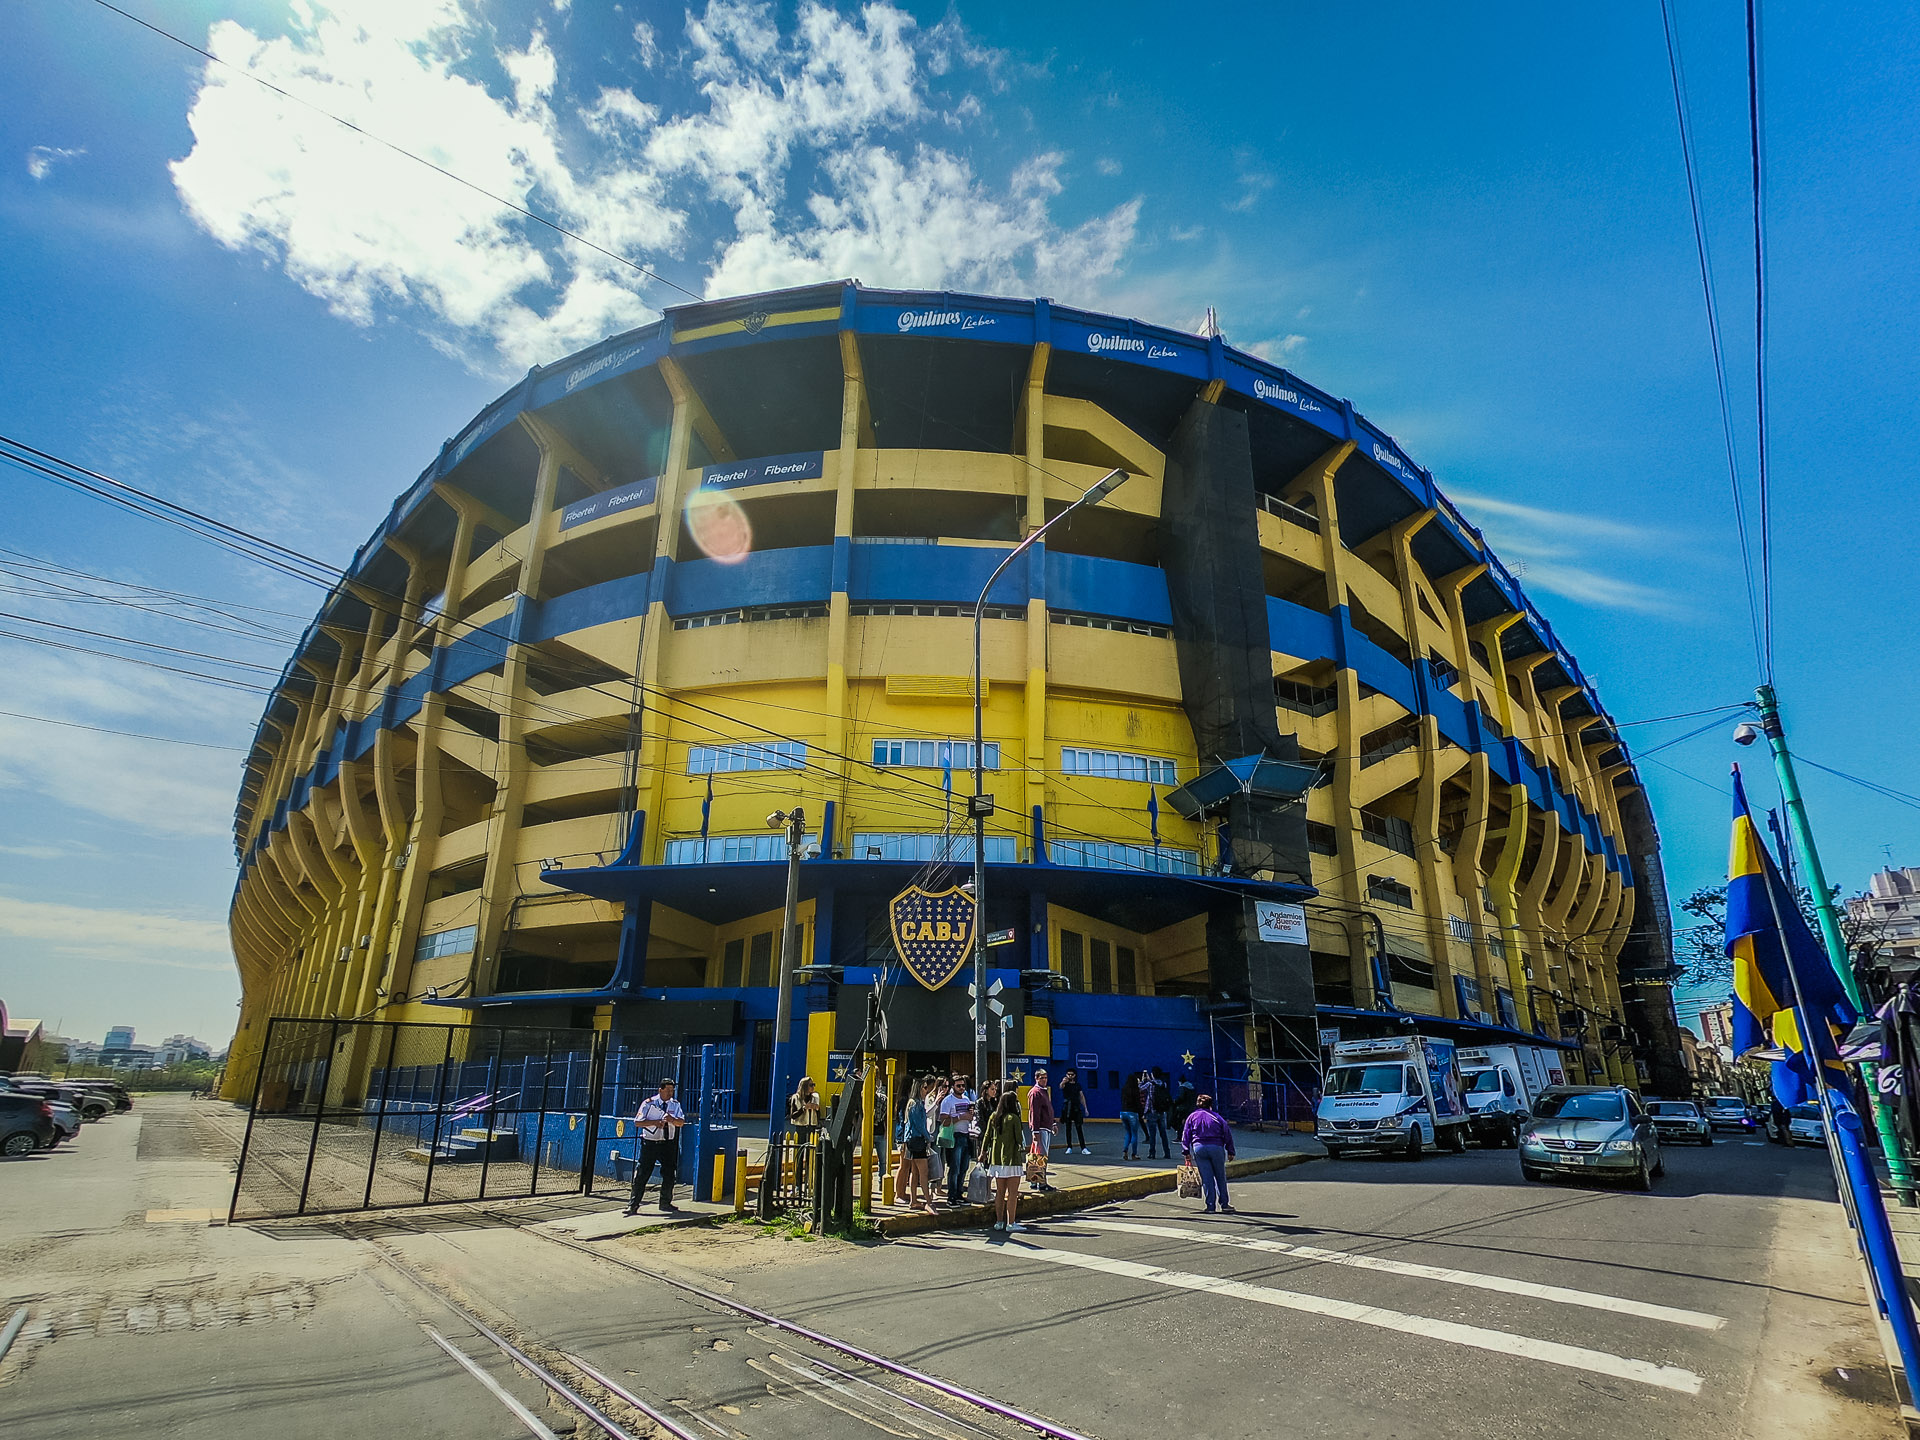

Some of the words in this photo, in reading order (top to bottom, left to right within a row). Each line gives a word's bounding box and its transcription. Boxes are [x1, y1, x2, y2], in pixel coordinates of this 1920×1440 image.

[898, 311, 960, 332] Quilmes
[961, 315, 996, 330] Lieber
[1087, 333, 1145, 352] Quilmes
[1147, 345, 1178, 359] Lieber
[565, 353, 612, 392] Quilmes
[1254, 379, 1298, 404] Quilmes
[707, 469, 748, 485] Fibertel
[764, 462, 807, 476] Fibertel
[565, 504, 597, 523] Fibertel
[608, 489, 643, 508] Fibertel
[1270, 911, 1303, 921] Andamios
[1275, 917, 1302, 926] Buenos
[901, 921, 967, 942] CABJ
[1274, 923, 1292, 931] Aires
[837, 1068, 844, 1076] 3
